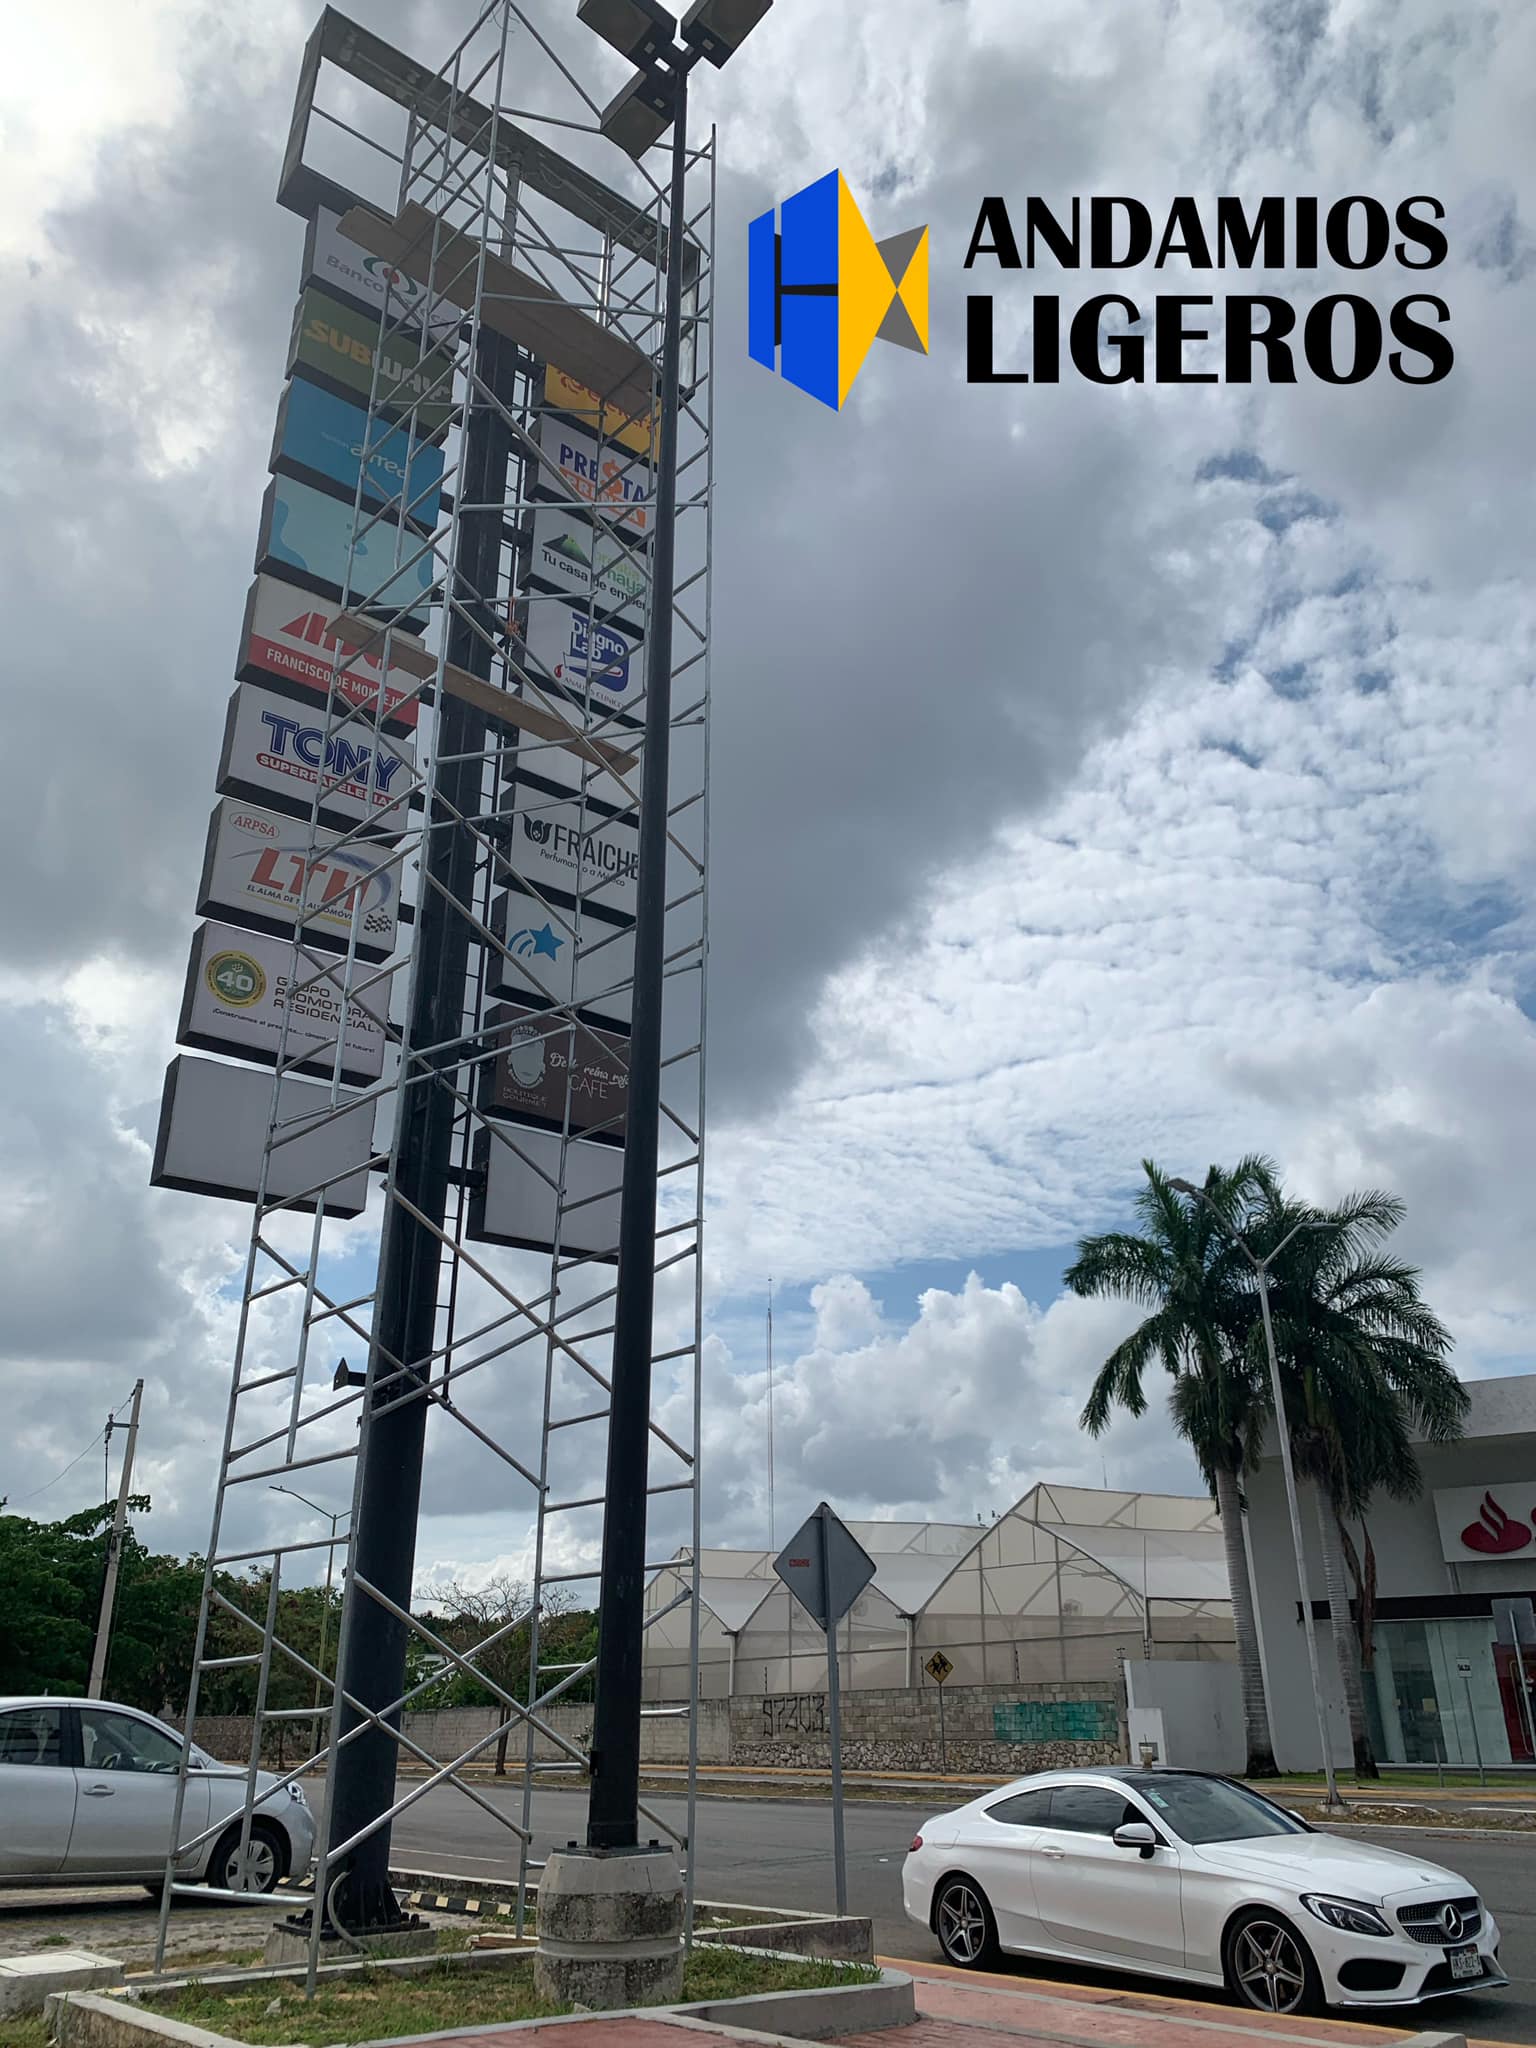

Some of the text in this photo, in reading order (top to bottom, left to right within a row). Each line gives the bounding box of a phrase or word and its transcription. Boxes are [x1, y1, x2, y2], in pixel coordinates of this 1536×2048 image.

[326, 255, 384, 293] Banco
[303, 319, 450, 400] SUBWAY
[541, 549, 557, 567] Tu
[560, 561, 588, 582] casa
[572, 620, 624, 656] Digno
[266, 647, 332, 683] FRANCISCO
[352, 681, 402, 707] MONEJO
[261, 711, 401, 792] TONY
[233, 815, 276, 837] ARPSA
[540, 848, 588, 873] Perfumano
[553, 824, 639, 880] FRAICHE
[251, 847, 372, 912] LTH
[257, 887, 282, 900] ALMA
[217, 971, 254, 992] 40
